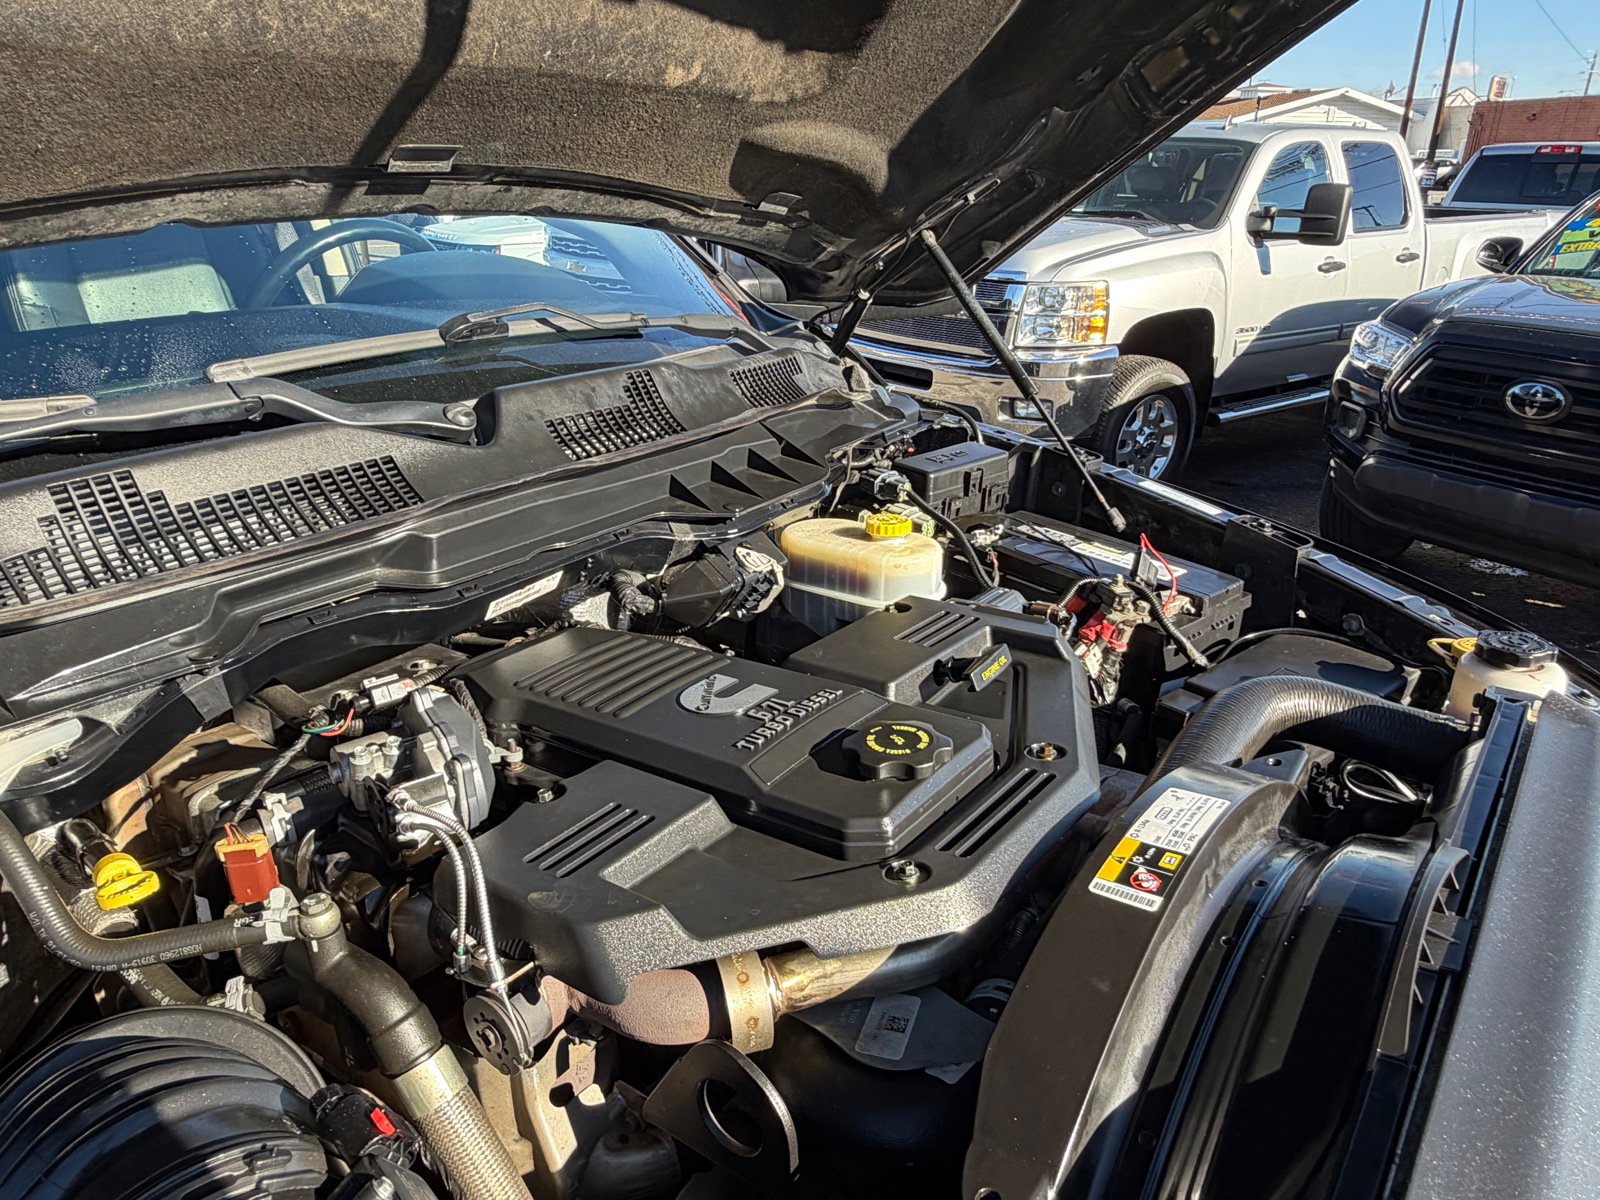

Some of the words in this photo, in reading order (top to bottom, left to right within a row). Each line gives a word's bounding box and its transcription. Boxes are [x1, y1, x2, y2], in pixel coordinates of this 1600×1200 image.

[981, 661, 1001, 681] ENGINE
[998, 655, 1008, 666] OIL
[731, 714, 795, 751] TURBO
[787, 688, 843, 718] DIESEL
[747, 697, 795, 723] 6.7L
